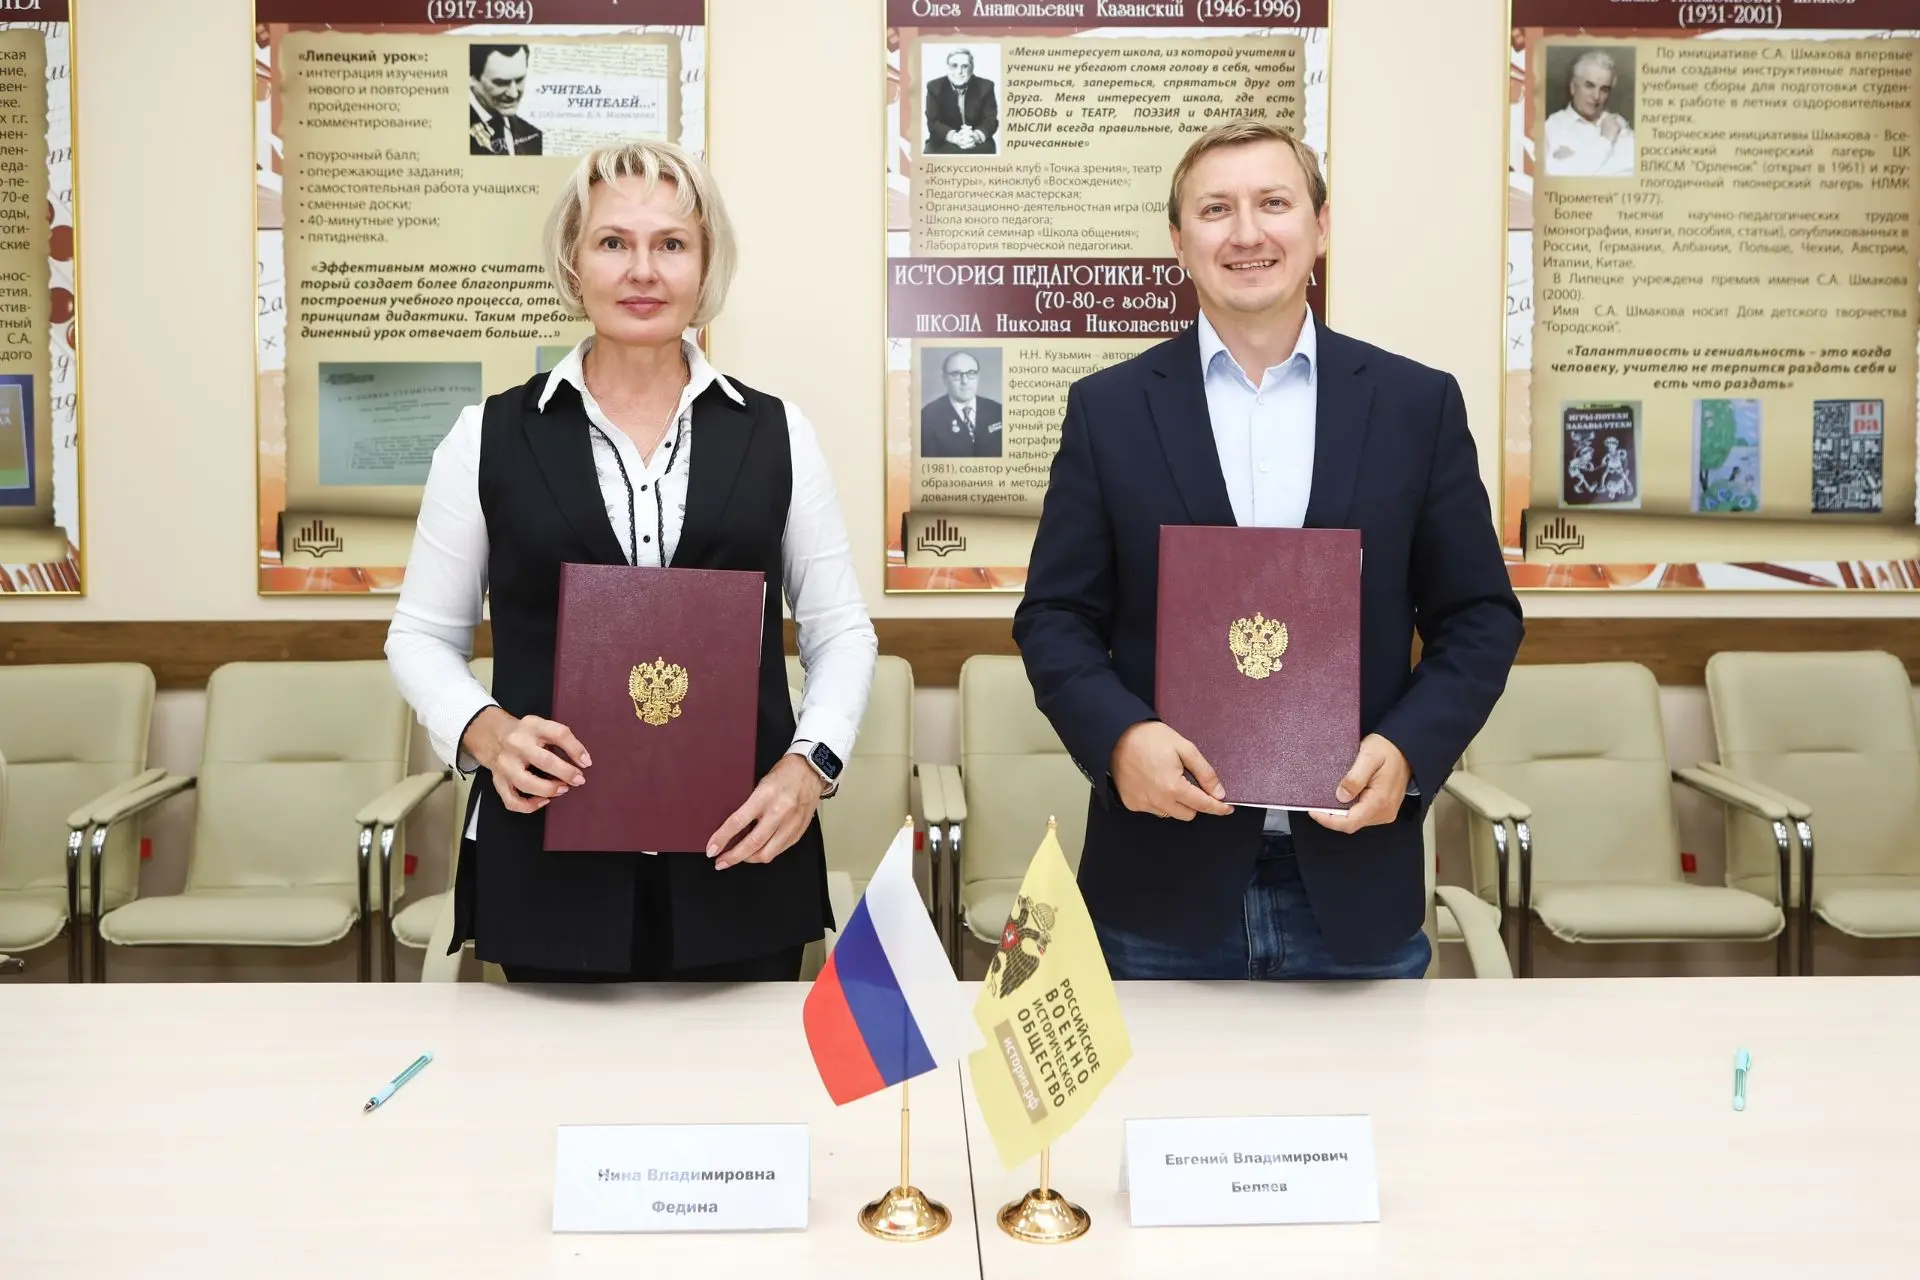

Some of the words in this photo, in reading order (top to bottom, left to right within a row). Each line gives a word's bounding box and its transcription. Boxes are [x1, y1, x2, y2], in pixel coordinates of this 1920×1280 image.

[428, 0, 534, 23] (1917-1984)
[972, 0, 1085, 17] Анатольевич
[1096, 0, 1185, 18] Казанский
[1196, 0, 1301, 23] (1946-1996)
[1679, 5, 1783, 28] (1931-2001)
[298, 49, 377, 64] «Липецкий
[1008, 46, 1046, 57] «Меня
[1047, 49, 1121, 60] интересует
[1165, 48, 1179, 57] из
[1180, 47, 1234, 59] которой
[1234, 49, 1287, 60] учителя
[1287, 49, 1296, 58] и
[305, 68, 384, 81] интеграция
[385, 69, 448, 81] изучения
[1006, 64, 1055, 74] ученики
[1057, 64, 1072, 72] не
[1073, 61, 1128, 74] убегают
[1129, 64, 1167, 72] сломя
[1168, 64, 1210, 74] голову
[1211, 64, 1219, 73] в
[1254, 62, 1296, 73] чтобы
[1163, 79, 1238, 90] спрятаться
[1243, 76, 1271, 90] друг
[1276, 79, 1296, 88] от
[307, 85, 356, 96] нового
[358, 86, 367, 95] и
[369, 85, 450, 98] повторения
[1054, 92, 1086, 103] Меня
[1097, 94, 1171, 105] интересует
[1234, 92, 1255, 103] где
[1265, 95, 1296, 103] есть
[1006, 107, 1058, 118] ЛЮБОВЬ
[1065, 110, 1074, 118] и
[1133, 107, 1181, 118] ПОЭЗИЯ
[1187, 110, 1196, 118] и
[1275, 107, 1296, 119] где
[1006, 122, 1053, 133] МЫСЛИ
[1055, 122, 1095, 133] всегда
[1177, 122, 1209, 136] даже
[306, 149, 383, 164] поурочный
[306, 167, 405, 179] опережающие
[925, 162, 1014, 176] Дискуссионный
[1015, 162, 1042, 176] клуб
[1043, 162, 1081, 173] «Точка
[1132, 165, 1163, 176] театр
[306, 183, 421, 194] самостоятельная
[423, 181, 470, 196] работа
[925, 186, 1014, 200] Педагогическая
[306, 200, 367, 210] сменные
[307, 214, 395, 229] 40-минутные
[925, 214, 963, 225] Школа
[964, 216, 1000, 225] юного
[925, 239, 999, 253] Лаборатория
[1001, 237, 1066, 253] творческой
[311, 261, 425, 276] «Эффективным
[428, 263, 477, 273] можно
[480, 264, 546, 274] считать
[895, 264, 1005, 286] ИСТОРИЯ
[300, 277, 351, 292] торый
[353, 277, 414, 290] создает
[416, 277, 458, 290] более
[300, 296, 388, 309] построения
[389, 293, 454, 309] учебного
[1035, 291, 1115, 314] (70-80-е
[300, 312, 381, 325] принципам
[474, 310, 516, 322] Таким
[916, 313, 982, 332] ШКОЛА
[996, 311, 1072, 333] Николая
[1085, 313, 1194, 332] Николаевич
[7, 334, 33, 346] С.А.
[300, 325, 372, 339] диненный
[373, 329, 407, 341] урок
[408, 329, 483, 338] отвечает
[1567, 344, 1690, 357] «Талантливость
[1692, 348, 1702, 357] и
[1703, 347, 1806, 358] гениальность
[1819, 348, 1849, 358] это
[1851, 345, 1893, 358] когда
[1622, 363, 1689, 376] учителю
[1691, 364, 1709, 373] не
[1710, 363, 1786, 376] терпится
[1787, 361, 1851, 376] раздать
[1853, 361, 1886, 374] себя
[1887, 365, 1897, 374] и
[1653, 379, 1689, 389] есть
[1691, 379, 1722, 389] что
[958, 465, 1004, 475] соавтор
[920, 477, 994, 490] образования
[998, 480, 1006, 488] и
[919, 493, 969, 505] дования
[1060, 977, 1101, 1075] РОССИЙСКОЕ
[1045, 987, 1089, 1085] ВОЕННО
[1032, 997, 1077, 1096] ИСТОРИЧЕСКОЕ
[1017, 1007, 1065, 1108] ОБЩЕСТВО
[1003, 1036, 1039, 1111] история.рф
[1164, 1151, 1229, 1166] Евгений
[1232, 1150, 1349, 1169] Владимирович
[646, 1167, 776, 1184] Владимировна
[1231, 1180, 1288, 1194] Беляев
[651, 1199, 719, 1216] Федина
